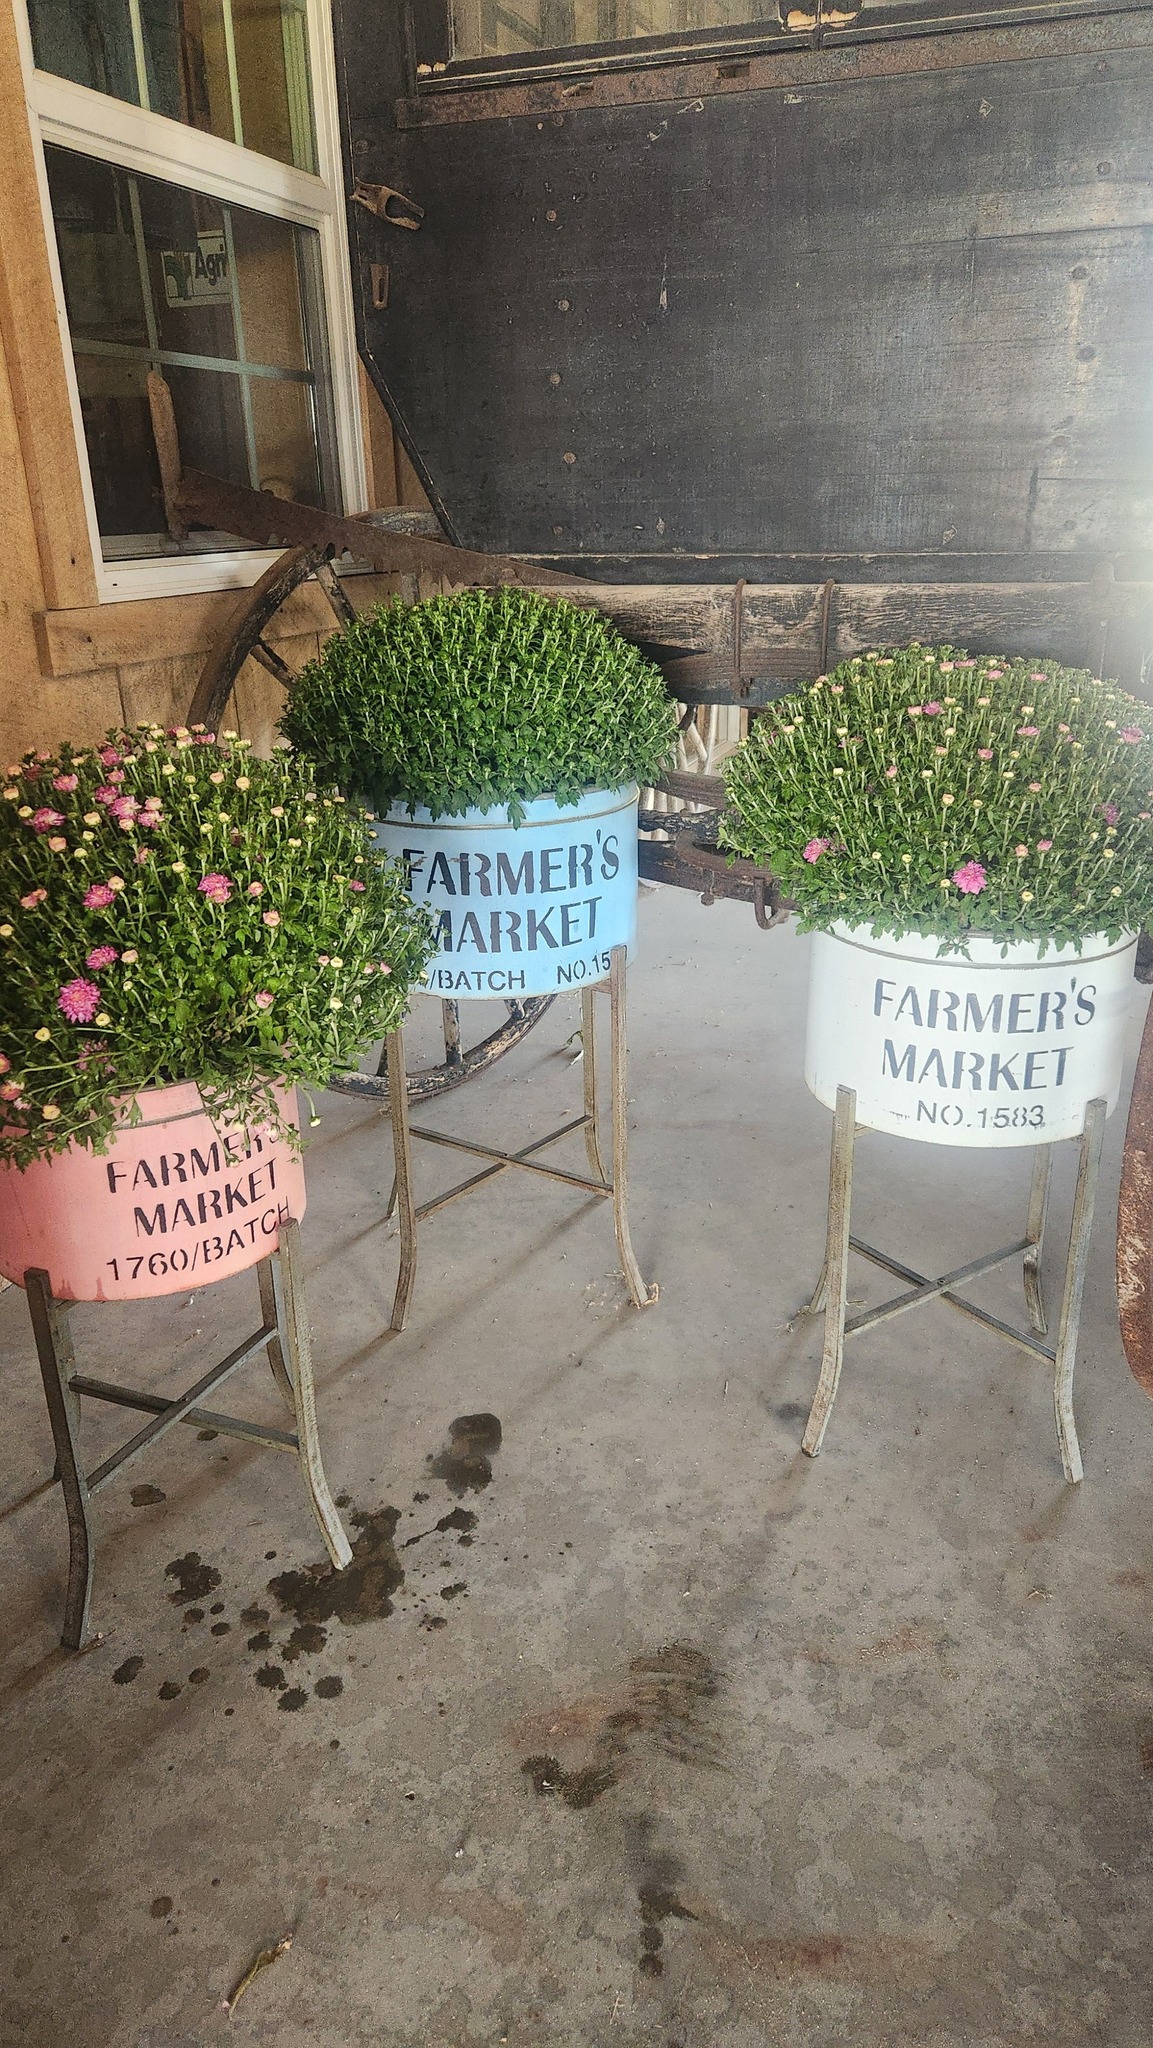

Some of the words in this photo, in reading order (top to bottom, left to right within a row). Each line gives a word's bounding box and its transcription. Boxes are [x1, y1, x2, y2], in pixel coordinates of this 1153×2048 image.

[402, 829, 620, 897] FARMER'S
[425, 897, 602, 954] MARKET
[429, 969, 526, 992] /BATCH
[557, 951, 611, 985] NO.15
[873, 976, 1097, 1034] FARMER'S
[882, 1038, 1075, 1092] MARKET
[916, 1100, 1045, 1129] NO.1583
[133, 1157, 277, 1238] MARKET
[106, 1195, 290, 1282] 1760/BATCH
